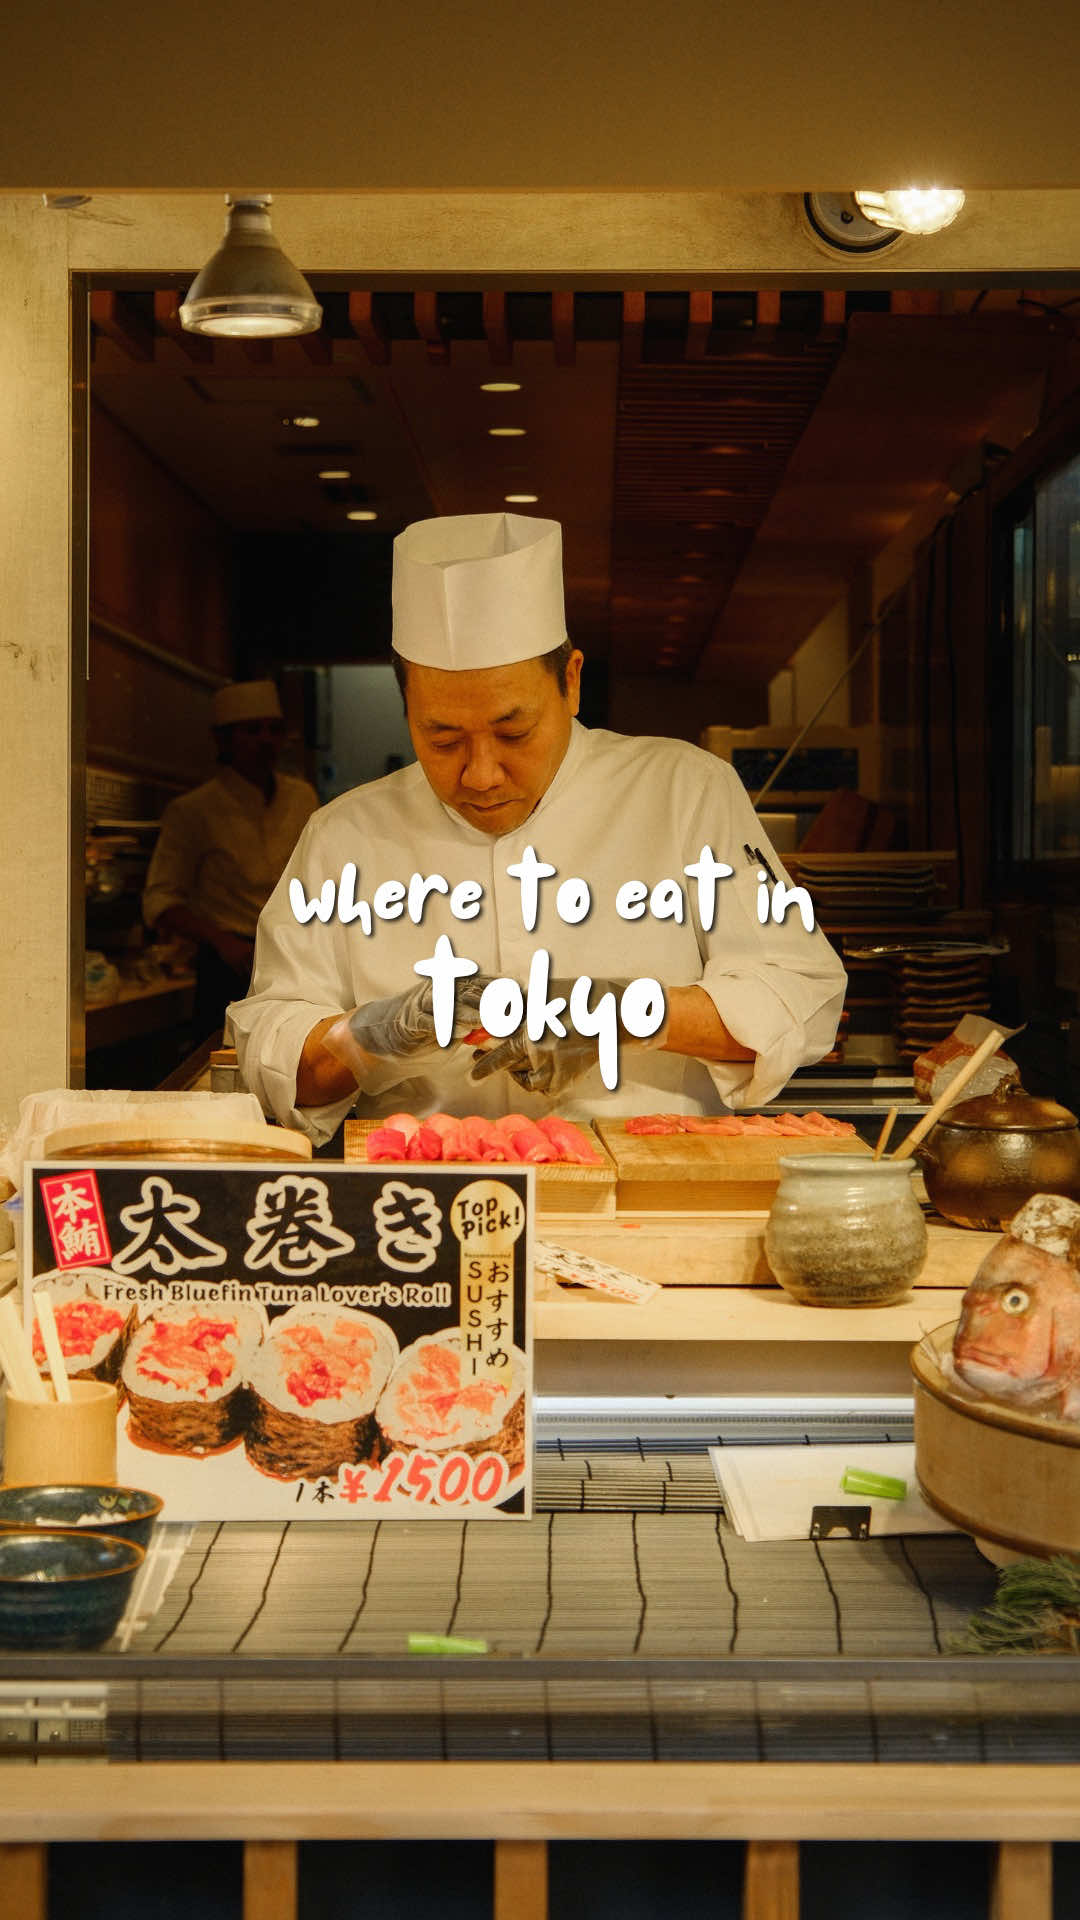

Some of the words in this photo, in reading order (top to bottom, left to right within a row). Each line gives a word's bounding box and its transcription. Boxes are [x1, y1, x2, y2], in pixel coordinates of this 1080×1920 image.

[52, 1183, 101, 1261] 本鮪
[115, 1178, 438, 1271] 太巻き
[457, 1197, 498, 1220] Top
[461, 1206, 520, 1240] Pick!
[103, 1283, 164, 1301] Fresh
[171, 1283, 251, 1301] Bluefin
[259, 1285, 313, 1303] Tuna
[320, 1286, 398, 1303] Lover's
[406, 1287, 448, 1304] Roll
[466, 1261, 482, 1376] SUSHI
[485, 1261, 510, 1368] おすすめ
[339, 1454, 504, 1504] ¥1500
